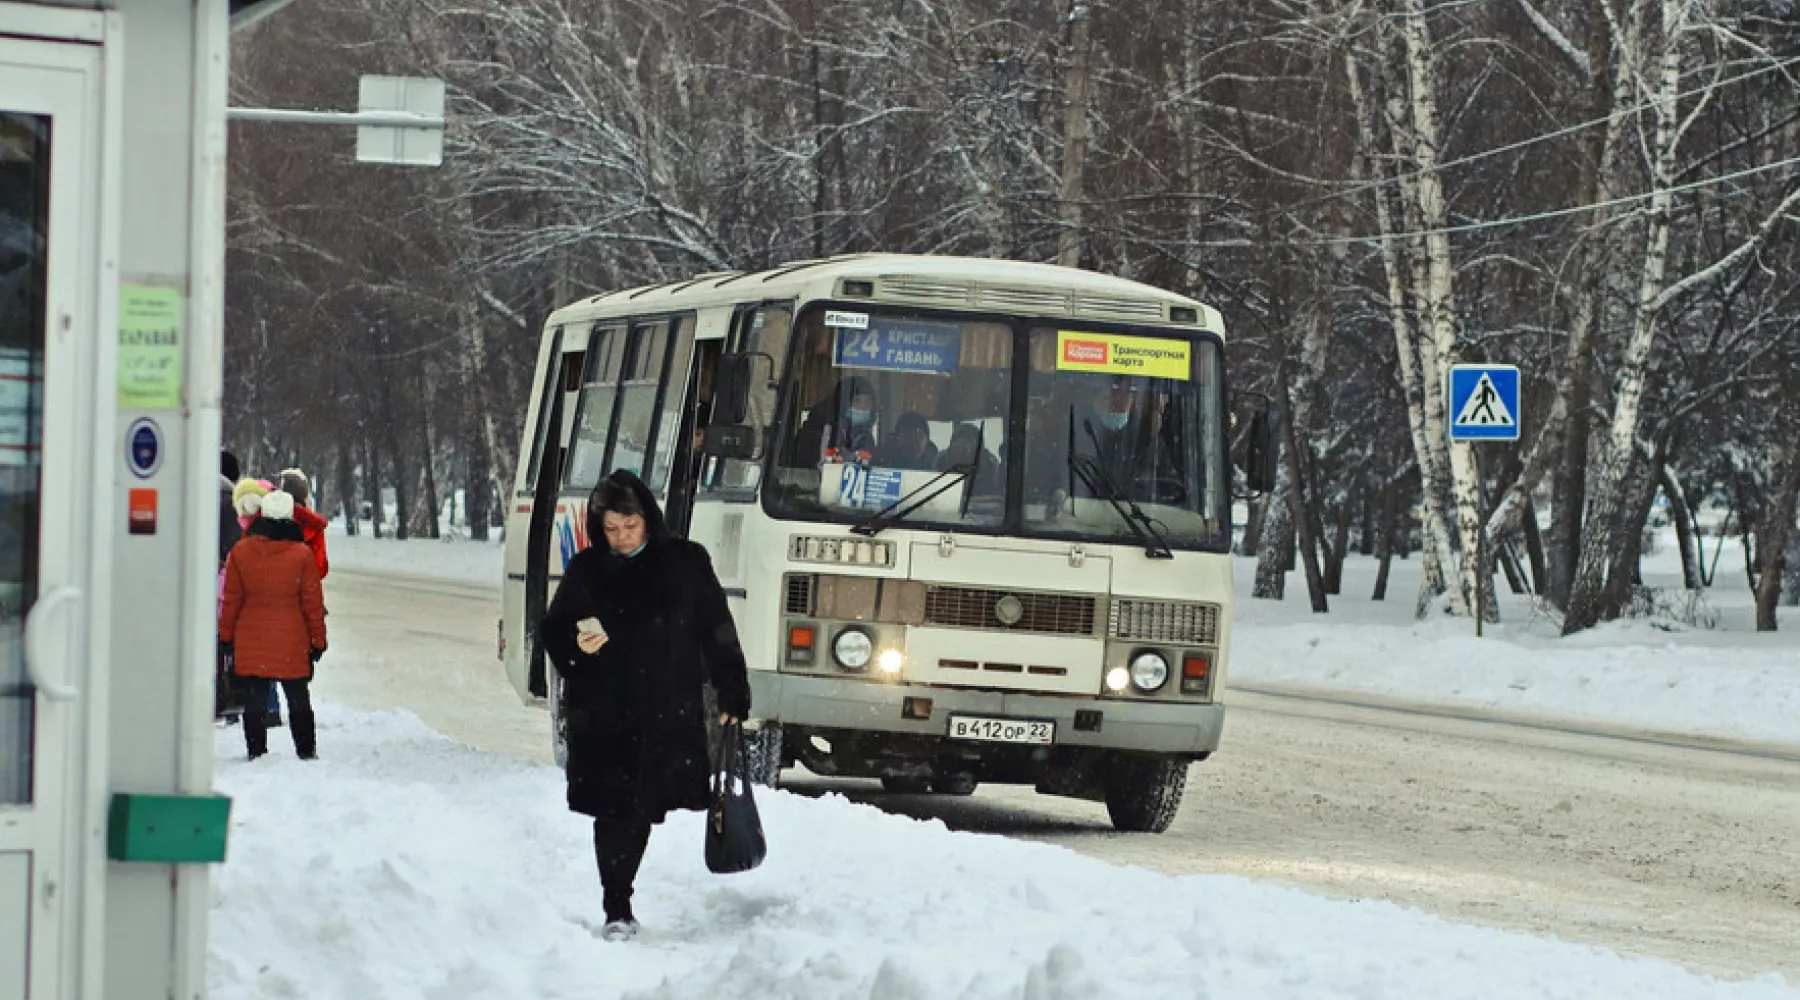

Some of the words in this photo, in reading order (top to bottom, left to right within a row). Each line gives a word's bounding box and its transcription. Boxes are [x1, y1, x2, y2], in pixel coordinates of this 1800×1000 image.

[843, 327, 880, 359] 24
[886, 349, 943, 365] ГАВАНЬ
[841, 464, 866, 508] 24
[1030, 724, 1047, 737] 22
